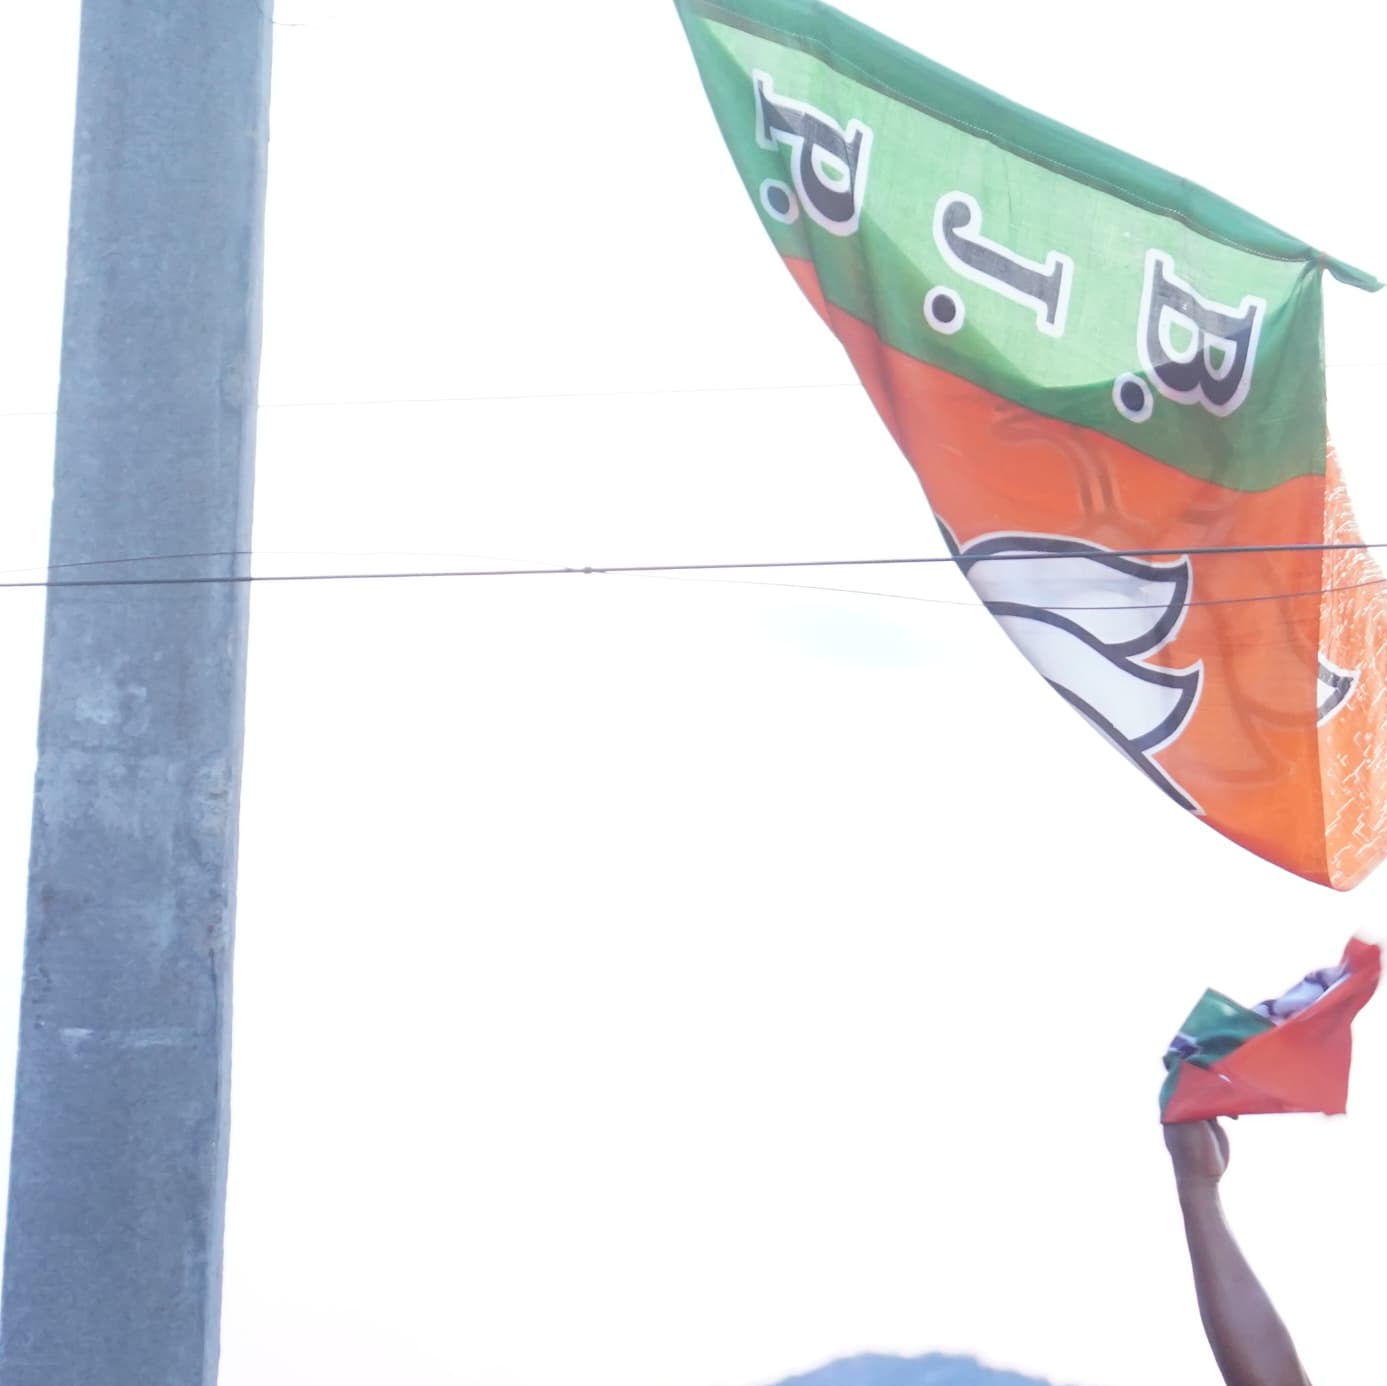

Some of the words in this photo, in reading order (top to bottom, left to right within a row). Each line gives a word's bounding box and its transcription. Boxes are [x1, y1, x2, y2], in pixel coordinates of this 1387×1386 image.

[755, 77, 866, 219] P.
[930, 200, 1066, 330] J.
[1117, 257, 1262, 416] B.
